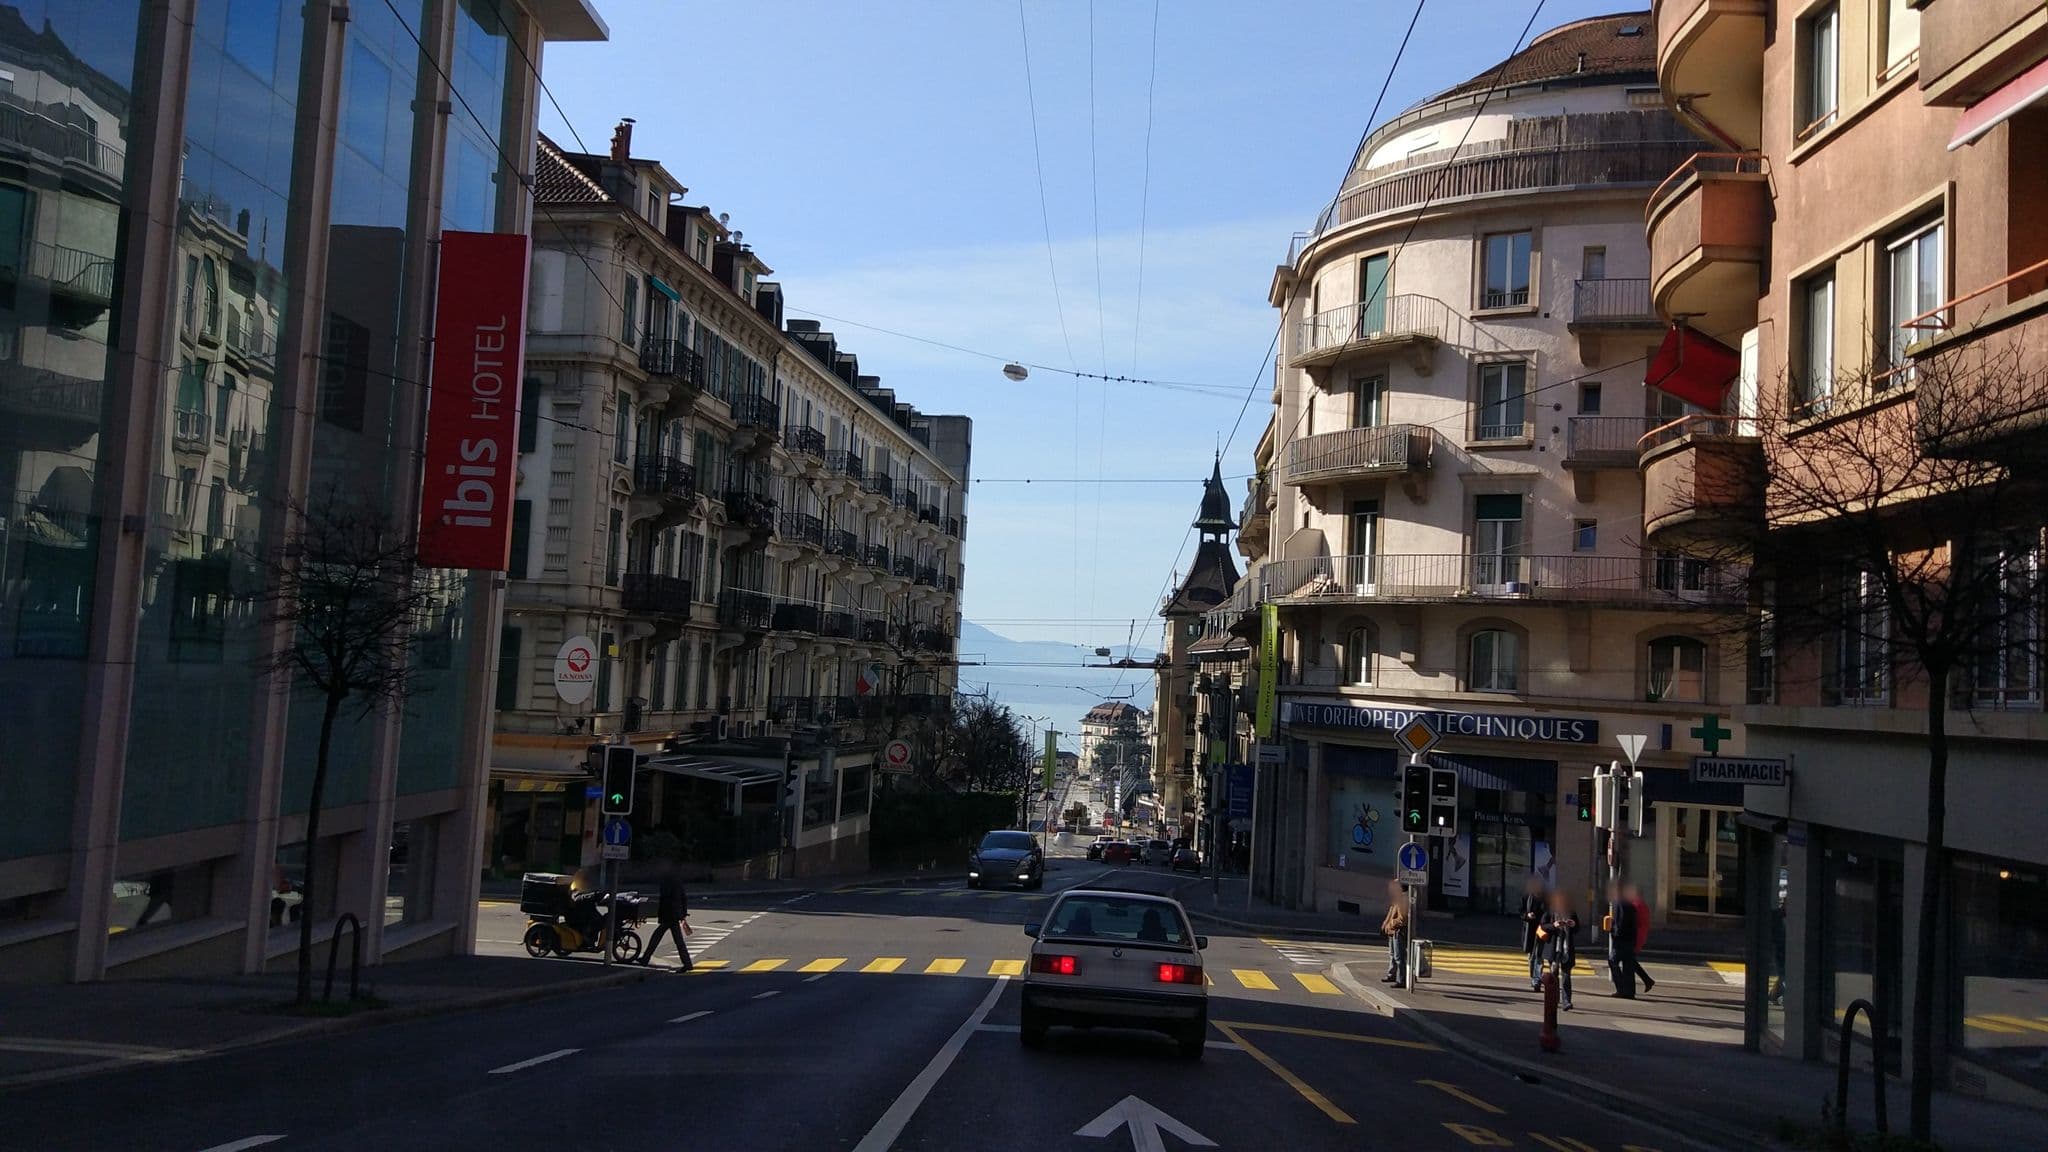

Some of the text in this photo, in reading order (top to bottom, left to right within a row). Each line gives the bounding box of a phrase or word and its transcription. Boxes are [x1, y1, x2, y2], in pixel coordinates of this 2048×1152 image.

[442, 314, 506, 528] ibis HOTEL
[1435, 712, 1585, 743] TECHNIQUES
[1700, 762, 1780, 781] PHARMACIE
